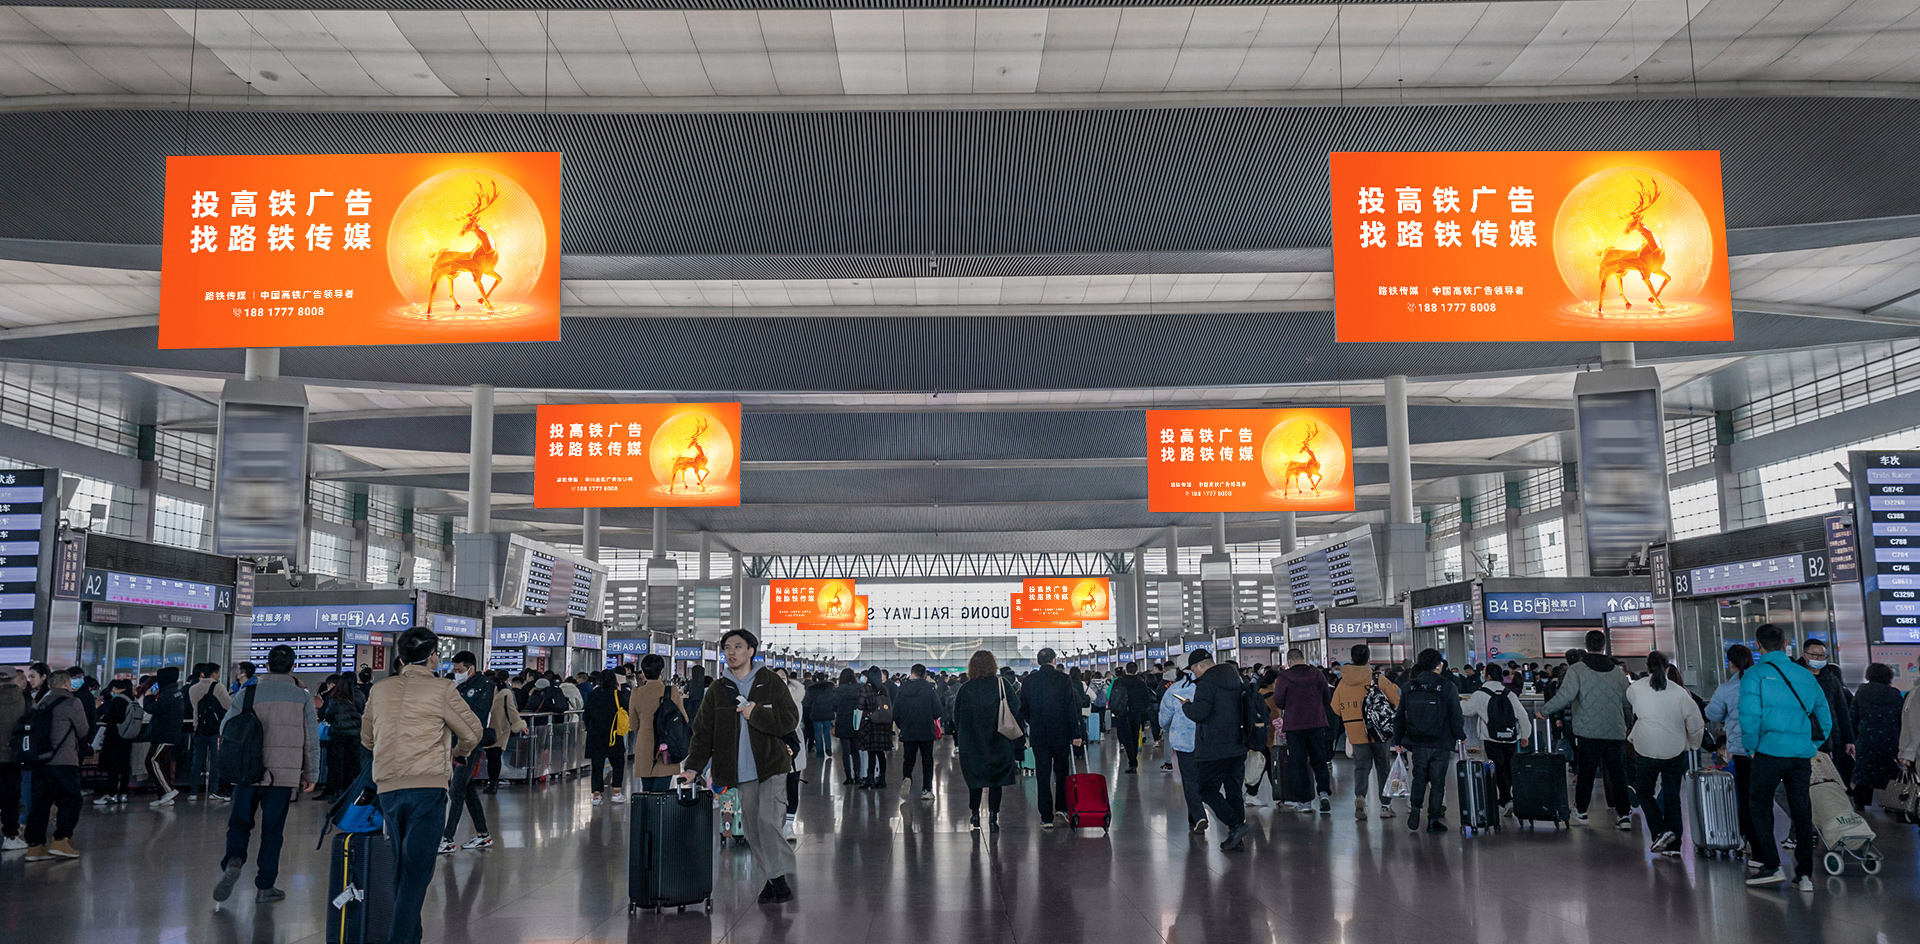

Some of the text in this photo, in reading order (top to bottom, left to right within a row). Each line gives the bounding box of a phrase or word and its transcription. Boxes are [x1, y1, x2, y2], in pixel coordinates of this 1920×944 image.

[190, 188, 373, 219] 投高铁广告
[1358, 185, 1535, 214] 投高铁广告
[189, 222, 372, 254] 找路铁传媒
[1359, 219, 1537, 249] 找路铁传媒
[204, 289, 355, 301] 路铁传媒 中国高铁广告领导者
[1378, 285, 1524, 296] 路铁传媒 中国高铁广告领导者
[244, 306, 325, 318] 188 1777 8008
[1418, 302, 1496, 313] 188 1777 8008
[550, 422, 643, 439] 投高铁广告
[1160, 427, 1253, 444] 投高铁广告
[549, 440, 642, 457] 找路铁传媒
[1161, 446, 1254, 462] 找路铁传媒
[1880, 455, 1901, 466] 车次
[1808, 556, 1826, 577] B2
[84, 574, 102, 596] A2
[1675, 574, 1689, 593] B3
[217, 590, 230, 609] A3
[1489, 600, 1533, 613] B4 B5
[1551, 600, 1577, 608] 检票口
[321, 613, 347, 622] 检票口
[365, 612, 410, 626] A4 A5
[1329, 623, 1361, 633] B6 B7
[531, 632, 563, 642] A6 A7
[1241, 636, 1266, 644] B8 B9
[622, 643, 634, 651] A8
[635, 643, 647, 651] A9
